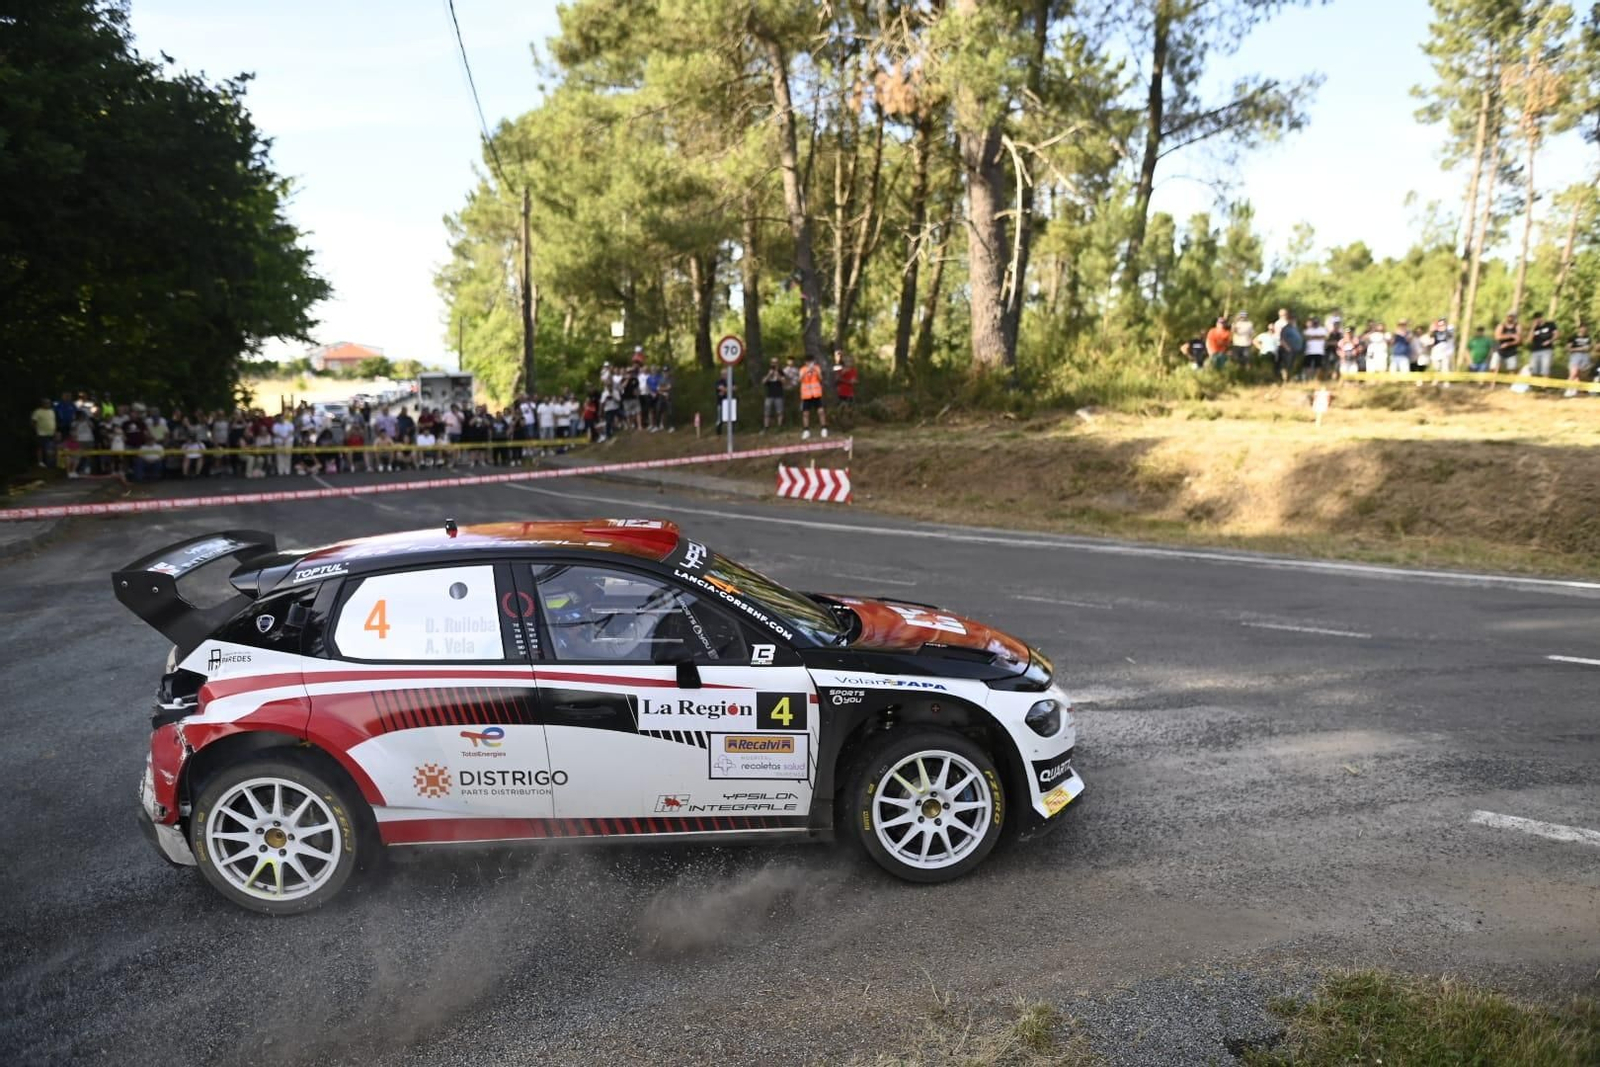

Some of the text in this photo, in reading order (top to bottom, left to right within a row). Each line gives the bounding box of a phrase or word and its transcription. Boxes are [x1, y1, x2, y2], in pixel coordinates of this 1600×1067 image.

[724, 345, 738, 356] 70
[294, 562, 342, 578] TOPTUL
[673, 569, 793, 640] LANCIA-CORSEHF.COM
[364, 599, 391, 639] 4
[444, 616, 496, 633] Ruiloba
[425, 637, 475, 654] A. Vela
[829, 689, 865, 697] SPORTS
[642, 699, 672, 715] La
[771, 697, 794, 726] 4
[738, 739, 781, 750] Recalvi
[741, 762, 805, 770] recoletas salud
[459, 770, 568, 786] DISTRIGO
[723, 792, 798, 800] YPSILON
[688, 803, 798, 812] INTEGRALE
